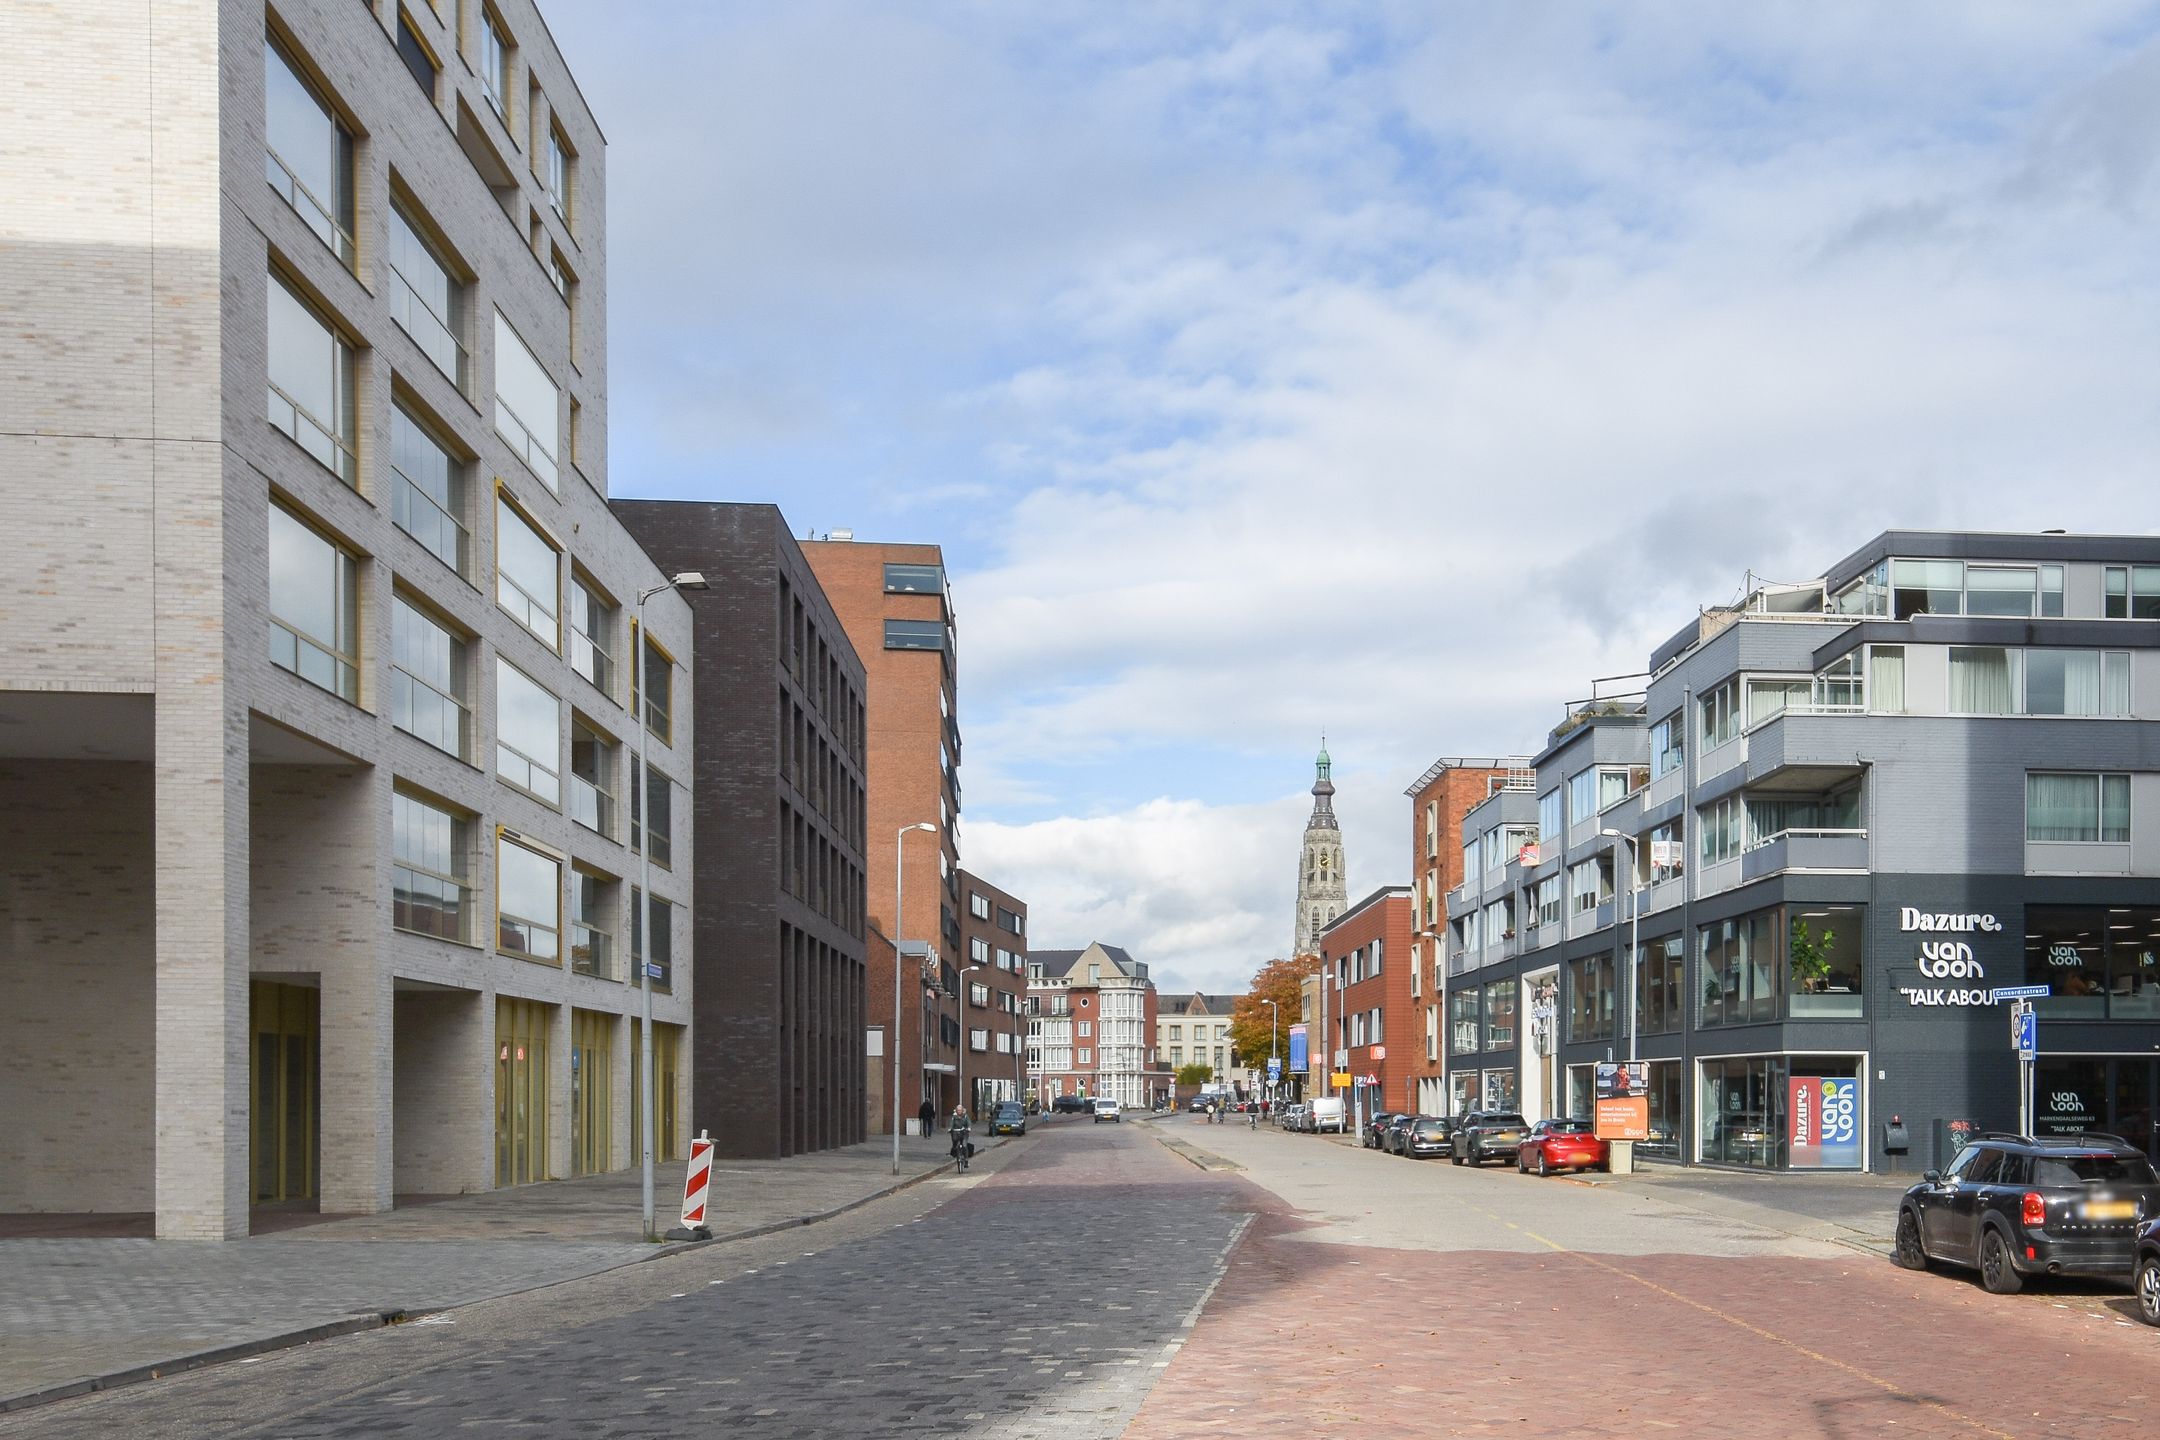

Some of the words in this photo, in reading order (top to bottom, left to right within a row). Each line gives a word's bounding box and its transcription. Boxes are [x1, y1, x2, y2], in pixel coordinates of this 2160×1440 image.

[1900, 907, 2002, 932] Dazure.
[1921, 941, 1973, 960] van
[1918, 957, 1984, 978] loon
[2050, 1101, 2085, 1112] loon
[2051, 1092, 2079, 1102] van
[1793, 1084, 1808, 1147] Dazure.
